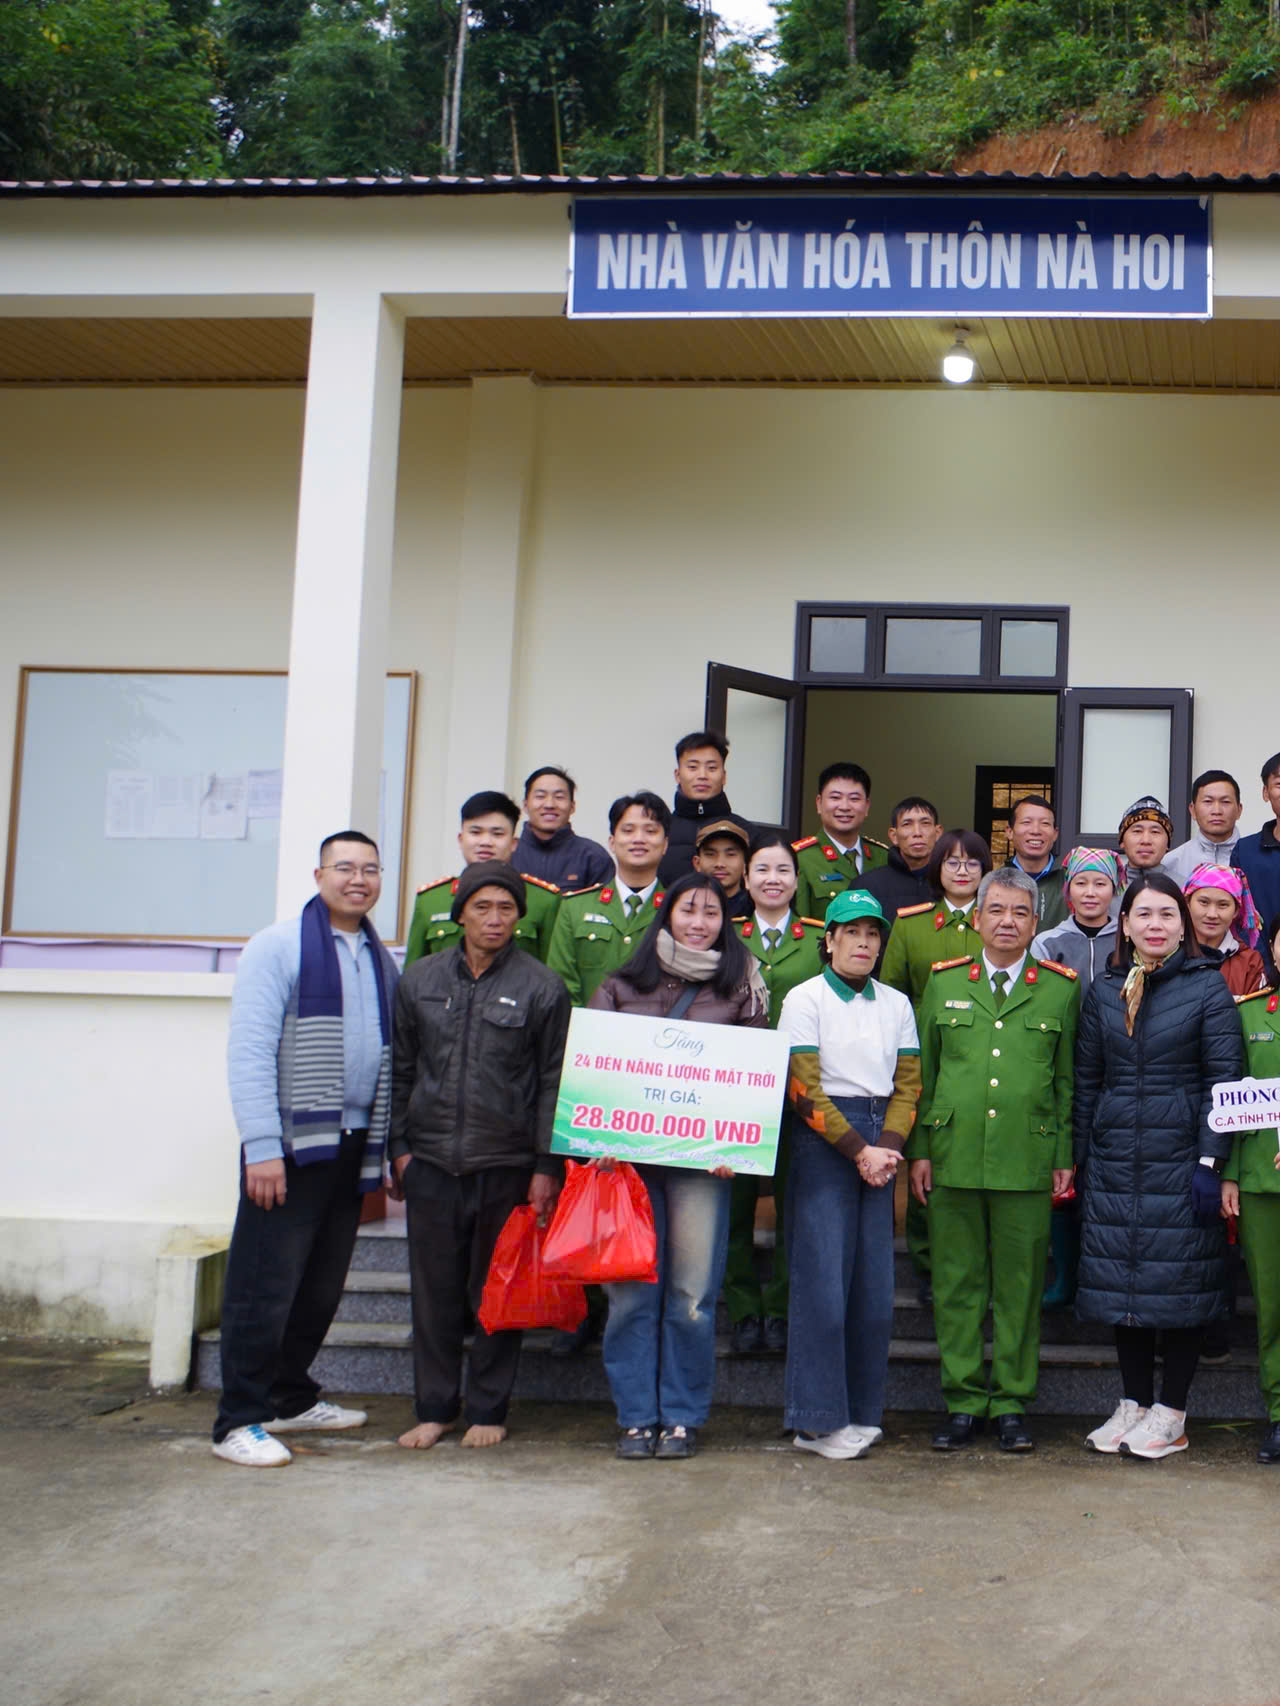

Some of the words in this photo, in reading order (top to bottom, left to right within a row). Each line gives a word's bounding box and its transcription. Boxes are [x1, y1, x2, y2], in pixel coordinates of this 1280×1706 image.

[597, 221, 688, 290] NHÀ
[701, 220, 789, 289] VĂN
[803, 218, 891, 289] HÓA
[905, 219, 1022, 290] THÔN
[1036, 220, 1098, 290] NÀ
[1112, 233, 1185, 291] HOI
[574, 1053, 590, 1068] 24
[595, 1053, 622, 1072] ĐÈN
[625, 1058, 664, 1077] NĂNG
[667, 1065, 711, 1084] LƯỢNG
[714, 1068, 743, 1088] MẶT
[746, 1068, 776, 1088] TRỜI
[643, 1087, 666, 1104] TRỊ
[670, 1088, 702, 1105] GIÁ:
[572, 1104, 706, 1139] 28.800.000
[714, 1120, 762, 1145] VNĐ
[1215, 1116, 1235, 1127] C.A
[1238, 1112, 1264, 1125] TỈNH
